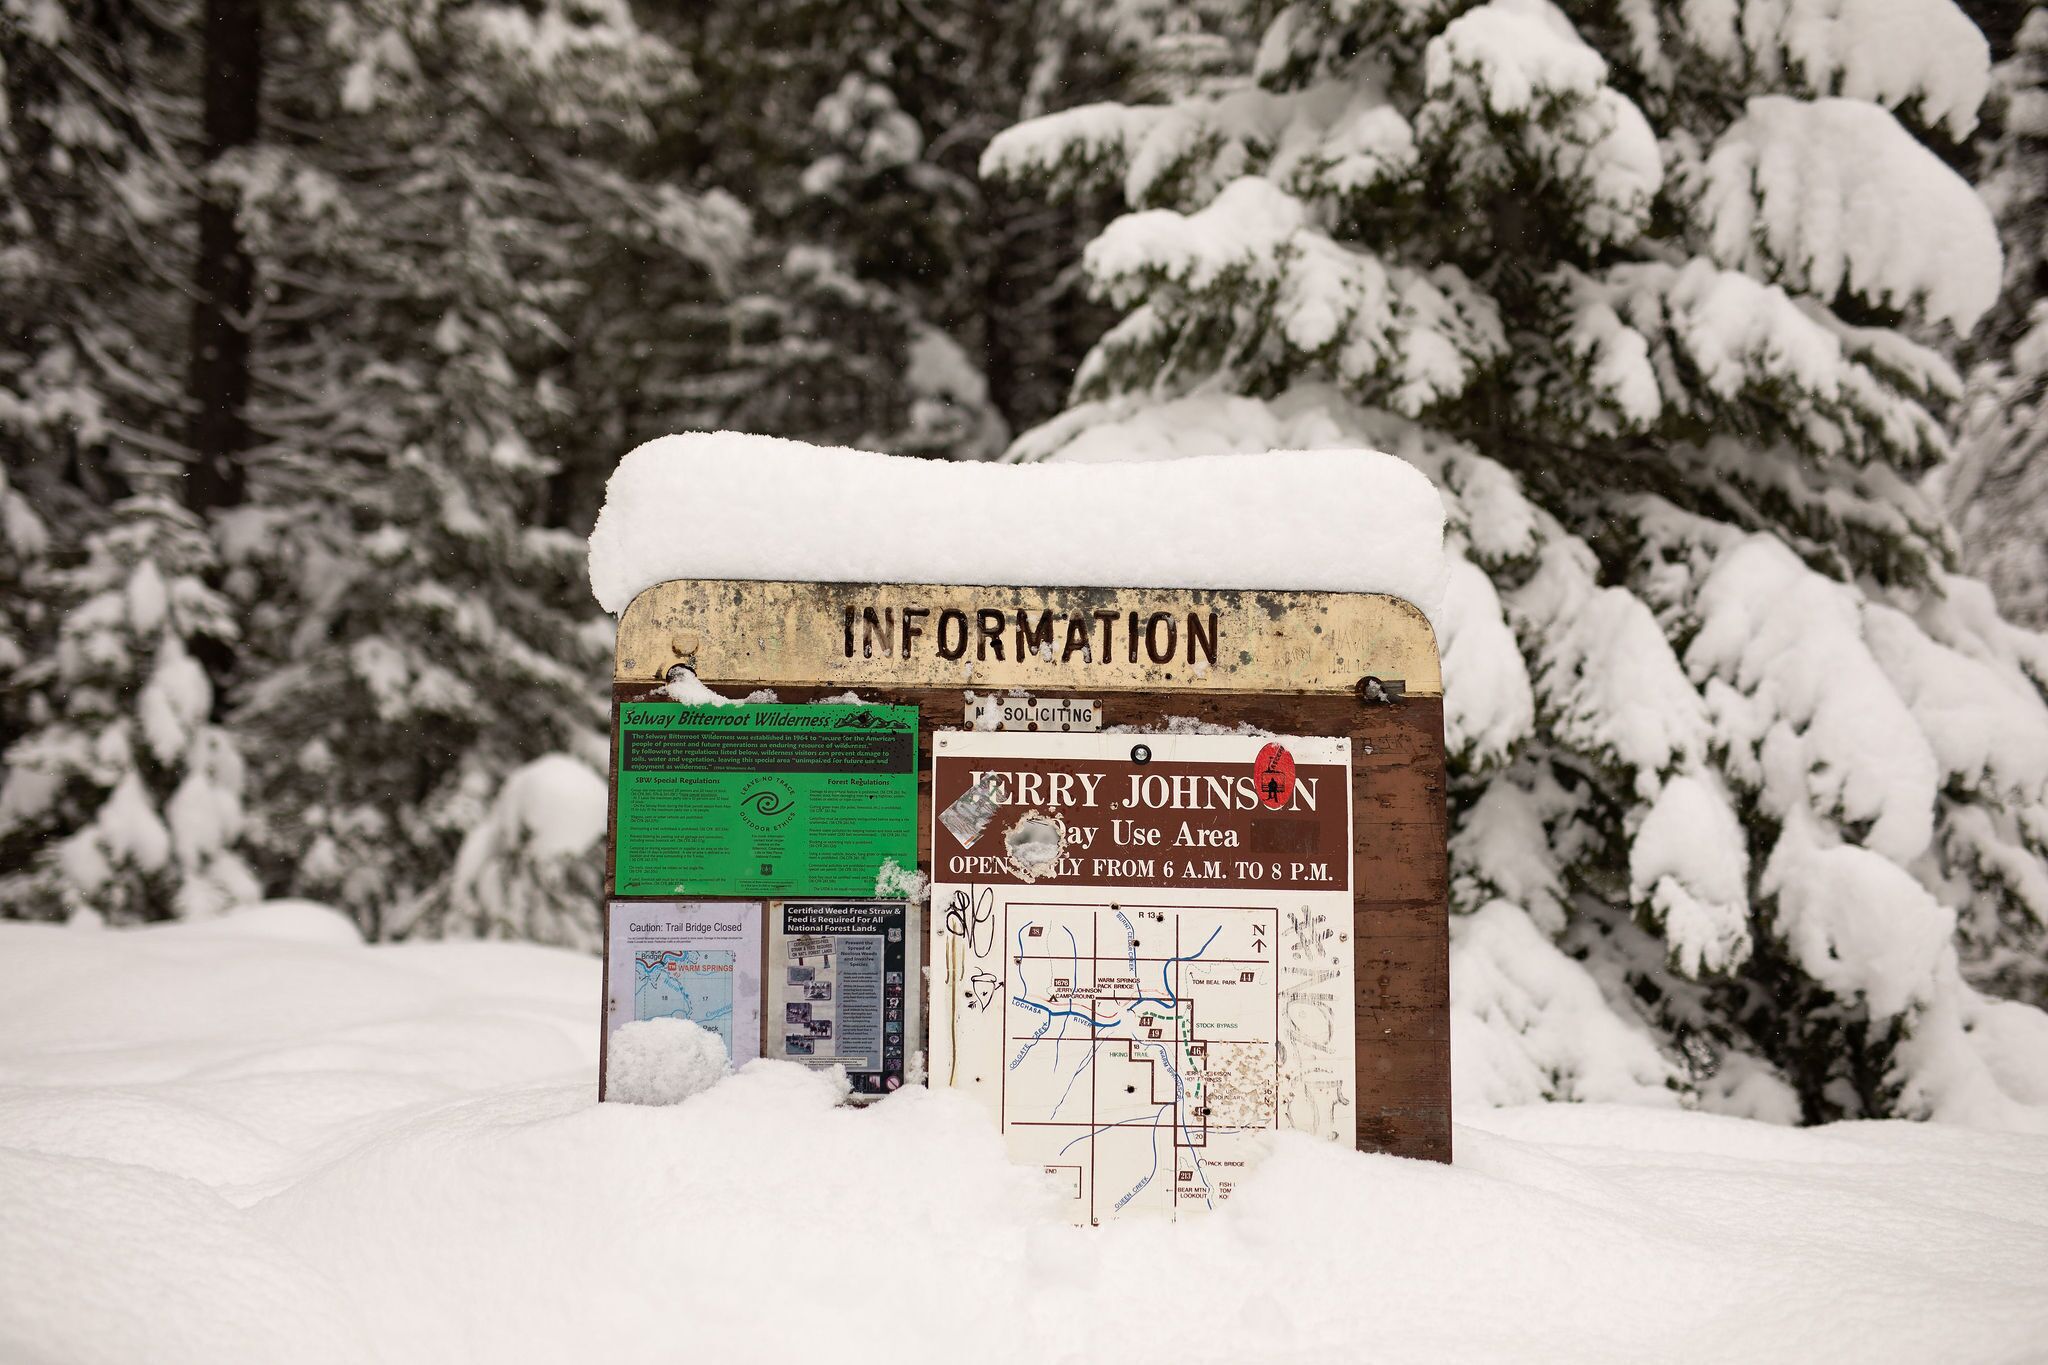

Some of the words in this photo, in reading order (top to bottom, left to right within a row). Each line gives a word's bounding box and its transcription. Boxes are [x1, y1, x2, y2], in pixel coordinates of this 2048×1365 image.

[843, 604, 1219, 664] INFORMATION
[624, 710, 676, 728] Selway
[678, 711, 750, 726] Bitterroot
[755, 712, 831, 727] Wilderness
[1004, 707, 1092, 722] SOLICITING
[654, 777, 678, 785] Special
[740, 778, 760, 796] LEAVE
[776, 778, 796, 796] TRACE
[969, 771, 1106, 807] JERRY
[1122, 774, 1319, 811] JOHNSN
[739, 811, 770, 832] OUTDOOR
[774, 811, 796, 831] ETHICS
[1052, 818, 1098, 849] ay
[1111, 820, 1161, 846] Use
[1173, 821, 1240, 847] Area
[949, 856, 1008, 875] OPEN
[1092, 858, 1155, 878] FROM
[1163, 860, 1174, 878] 6
[1182, 860, 1227, 878] A.M.
[1234, 861, 1264, 880] TO
[1272, 862, 1282, 880] 8
[1291, 862, 1333, 882] P.M.
[629, 922, 663, 932] Caution:
[666, 923, 684, 932] Trail
[686, 923, 712, 933] Bridge
[714, 922, 742, 932] Closed
[1116, 913, 1132, 930] BURNT
[1252, 924, 1266, 936] N
[1074, 1017, 1092, 1028] RIVER
[1010, 1043, 1030, 1068] COLGATE
[1114, 1192, 1132, 1209] QUEEN
[1132, 1176, 1149, 1193] CREEK
